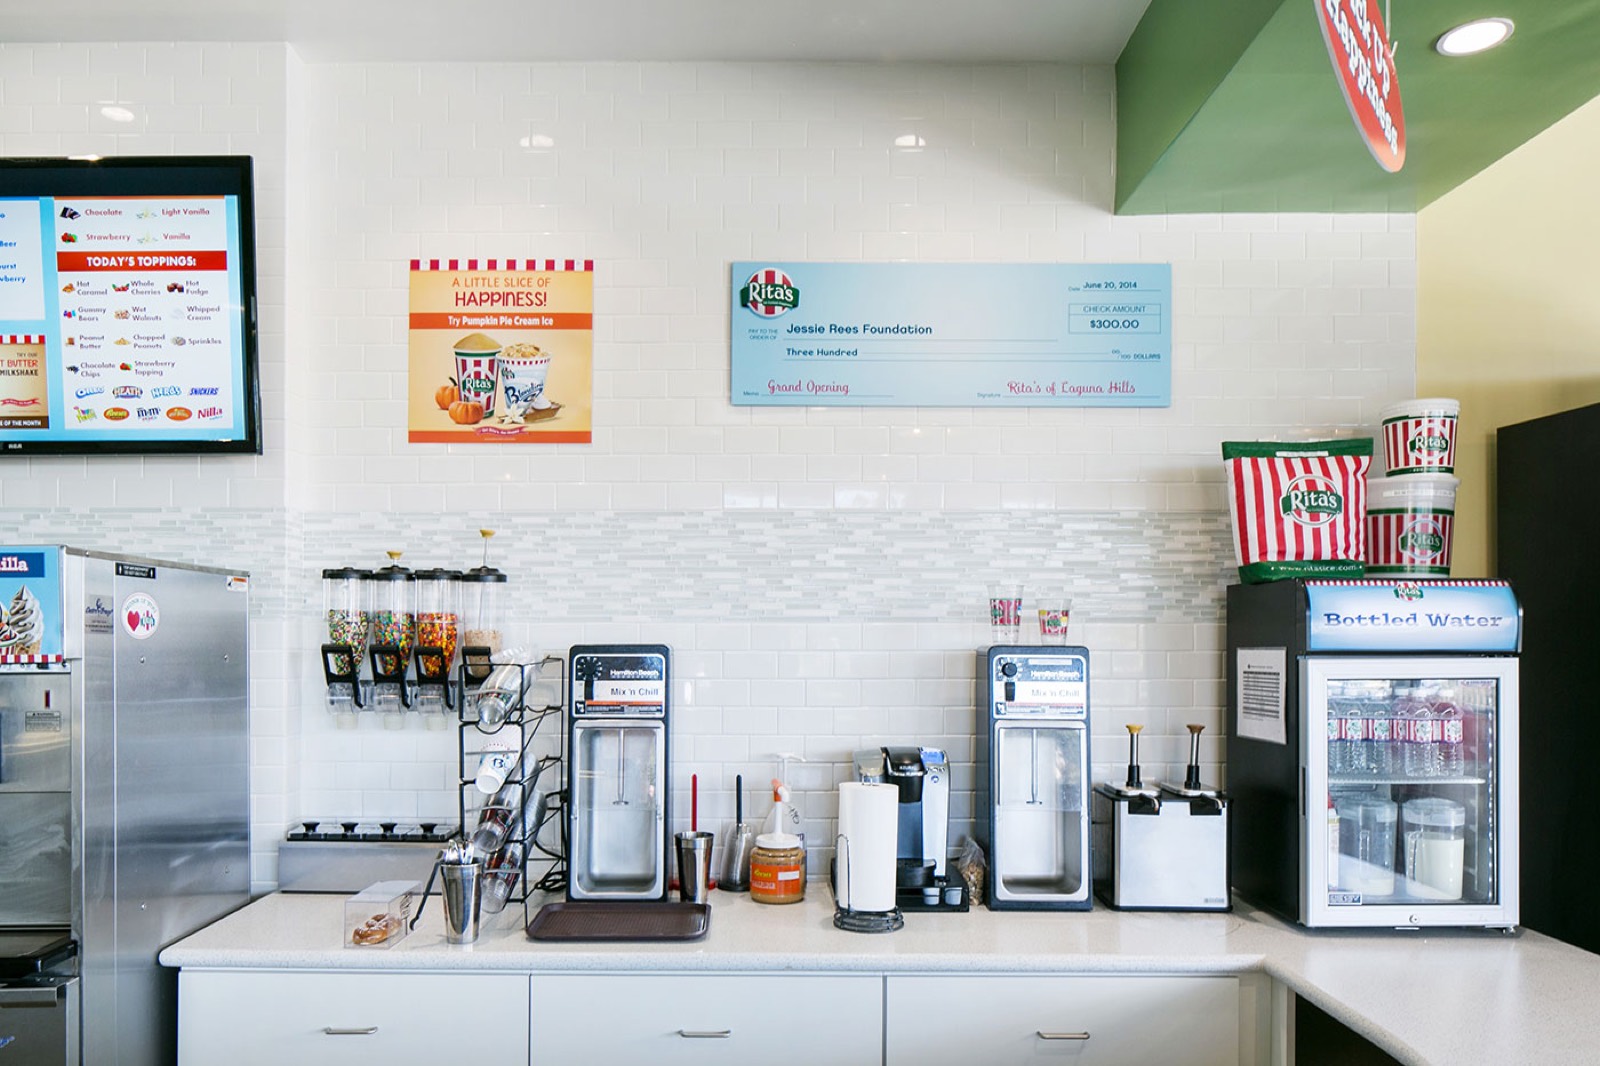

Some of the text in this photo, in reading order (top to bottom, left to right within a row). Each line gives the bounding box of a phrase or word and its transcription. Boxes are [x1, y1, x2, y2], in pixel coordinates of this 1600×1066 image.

[1373, 24, 1391, 101] Up
[84, 207, 210, 218] Chocolate Light Vanilla
[86, 233, 191, 243] Strawberry Vanilla
[86, 255, 197, 267] TODAY'S TOPPINGS:
[130, 279, 155, 287] Whole
[452, 277, 551, 288] A LITTLE SLICE OF
[1104, 281, 1117, 289] 20,
[1119, 281, 1137, 289] 2014
[185, 288, 208, 296] Fudge
[749, 281, 794, 302] Rita's
[455, 291, 547, 307] HAPPINESS!
[78, 306, 107, 314] Gummy
[186, 305, 221, 313] Whipped
[448, 315, 553, 327] Try Pumpkin Pie Cream Ice
[1090, 319, 1139, 329] $300.00
[787, 324, 933, 335] Jessie Rees Foundation
[786, 348, 858, 357] Three Hundred
[8, 360, 38, 368] BUTTER
[465, 378, 492, 391] Rita's
[767, 380, 803, 395] Grand
[807, 381, 849, 395] Opening
[1007, 381, 1041, 395] Rita's
[1046, 381, 1056, 396] of
[1061, 381, 1104, 396] Laguna
[1107, 381, 1136, 394] Hills
[197, 407, 223, 419] Nilla
[1415, 435, 1447, 450] Rita's
[1290, 489, 1338, 510] Rita's
[1408, 531, 1441, 547] Rita's
[1323, 613, 1503, 627] Bottled Water
[638, 687, 659, 696] Chill
[1031, 689, 1047, 697] Mix
[1058, 689, 1080, 697] Chill
